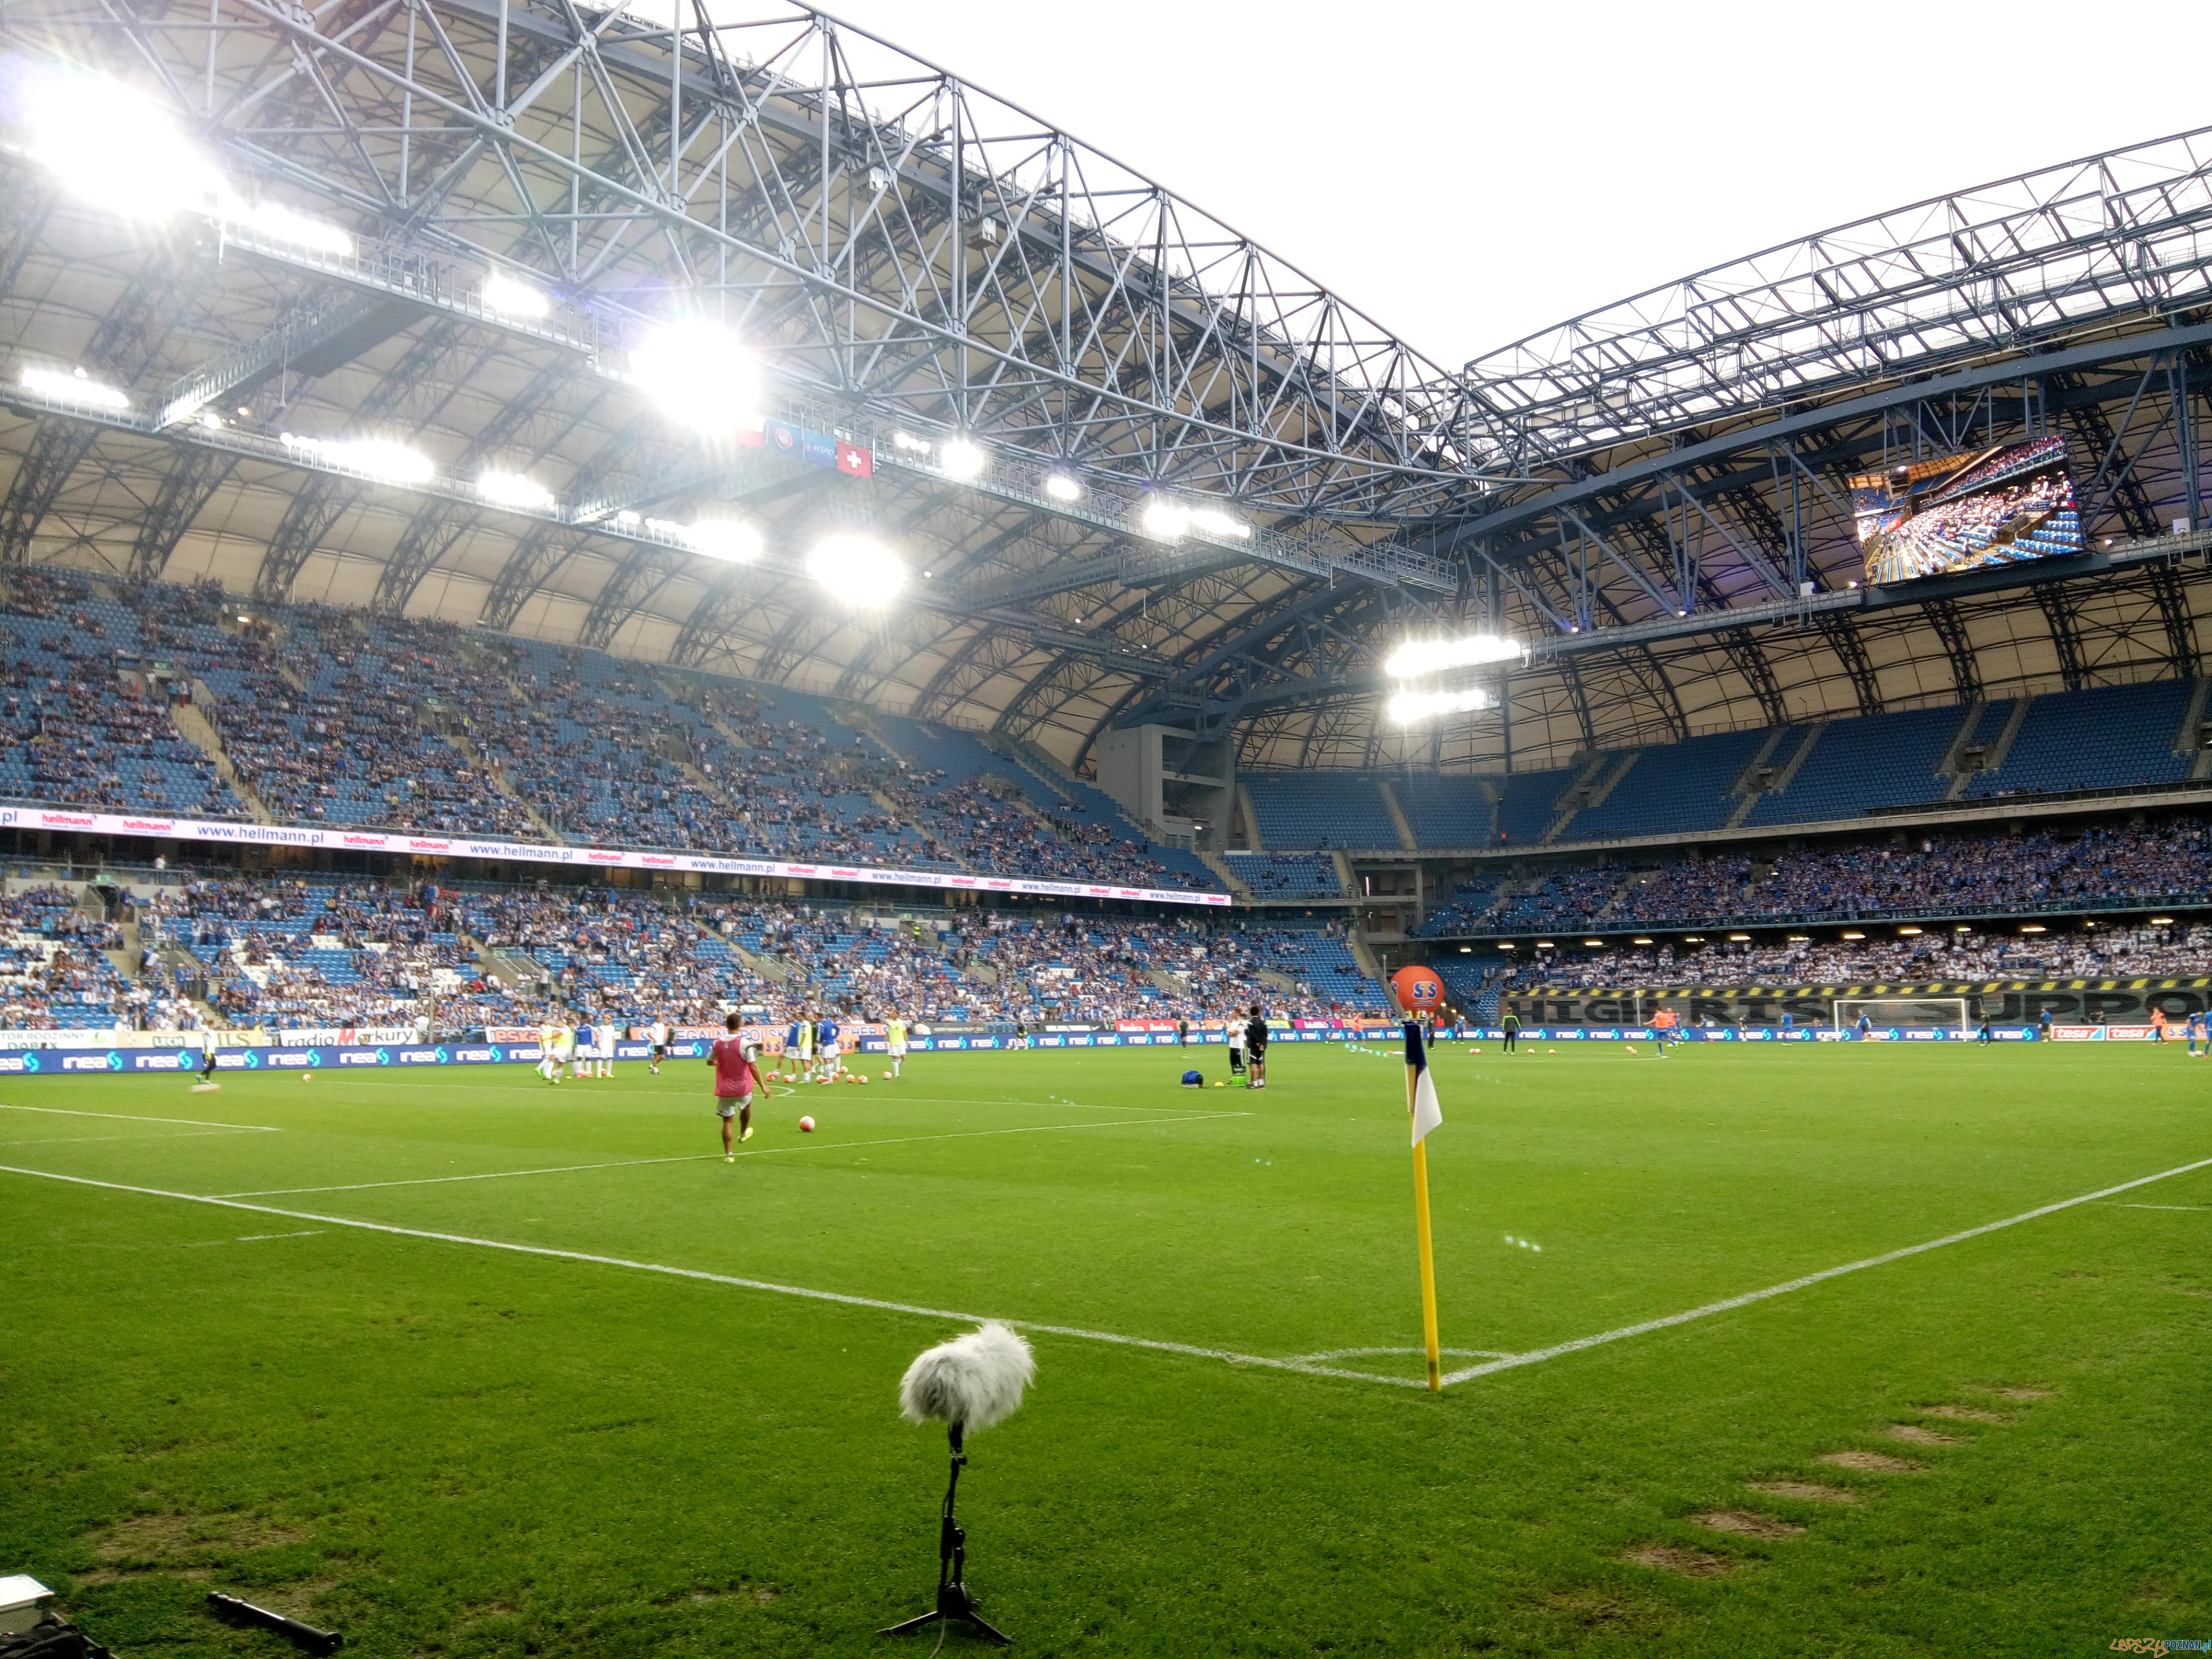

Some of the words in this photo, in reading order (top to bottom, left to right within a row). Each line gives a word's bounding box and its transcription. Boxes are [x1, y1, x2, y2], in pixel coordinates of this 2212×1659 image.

[43, 814, 93, 825] hellmann
[124, 820, 171, 831] hellmann
[197, 826, 324, 845] www.hellmann.pl
[344, 835, 385, 845] hellmann
[410, 840, 449, 850] hellmann
[469, 845, 573, 861] www.hellmann.pl
[691, 859, 775, 874] www.hellmann.pl
[872, 872, 941, 884] www.hellmann.pl
[1022, 883, 1081, 895] www.hellmann.pl
[1412, 981, 1437, 1000] STS
[2055, 1028, 2088, 1038] tesa
[2111, 1028, 2144, 1038] tesa
[217, 1033, 250, 1047] ILS
[287, 1033, 334, 1047] radio
[268, 1054, 307, 1066] inea
[340, 1052, 377, 1064] inea
[400, 1050, 436, 1062] inea
[456, 1049, 490, 1061] inea
[63, 1056, 107, 1069] inea
[136, 1055, 178, 1068] inea
